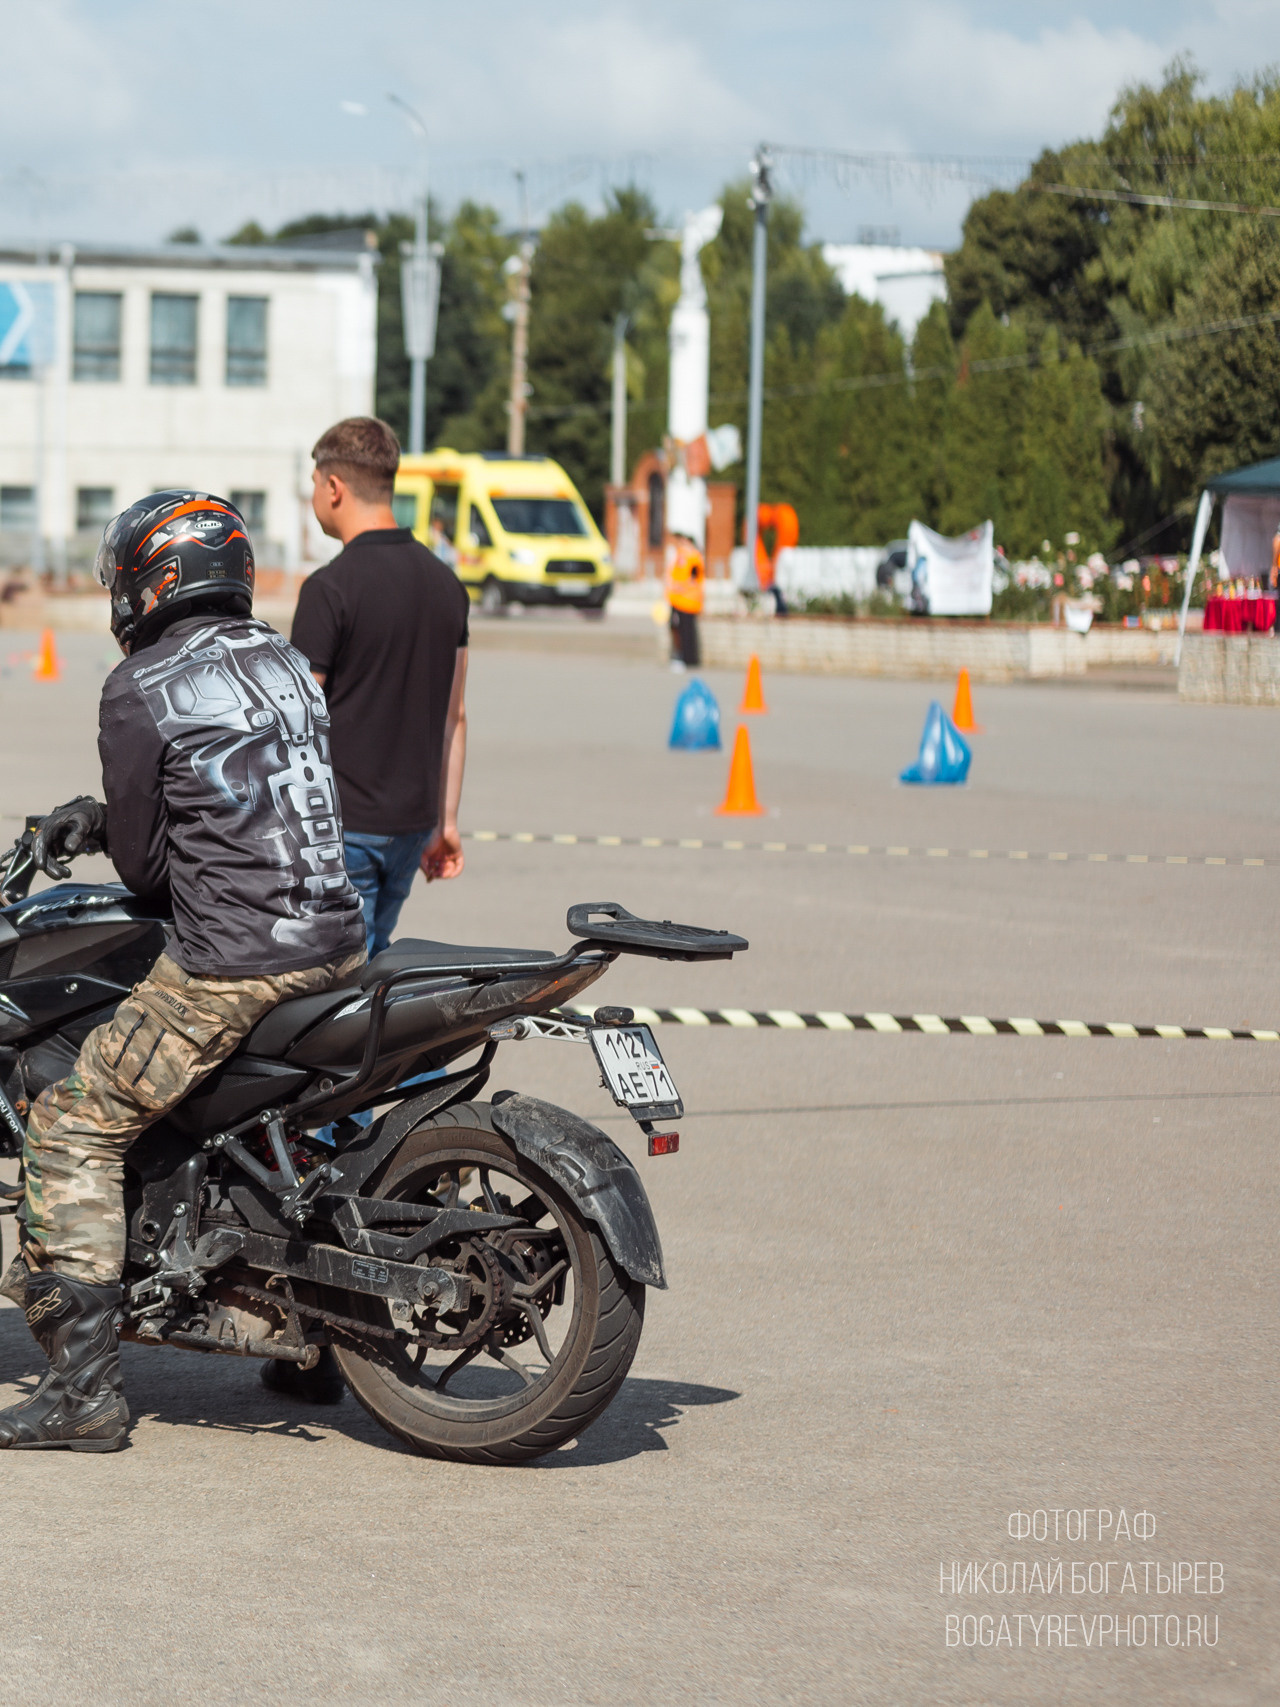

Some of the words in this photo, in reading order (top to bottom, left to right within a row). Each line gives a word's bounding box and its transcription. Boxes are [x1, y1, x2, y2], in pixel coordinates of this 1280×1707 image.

[155, 989, 190, 1018] HYPERLOOK
[605, 1031, 648, 1059] 1127
[635, 1061, 651, 1071] RUS
[645, 1070, 673, 1097] 71
[5, 1110, 19, 1134] Iron
